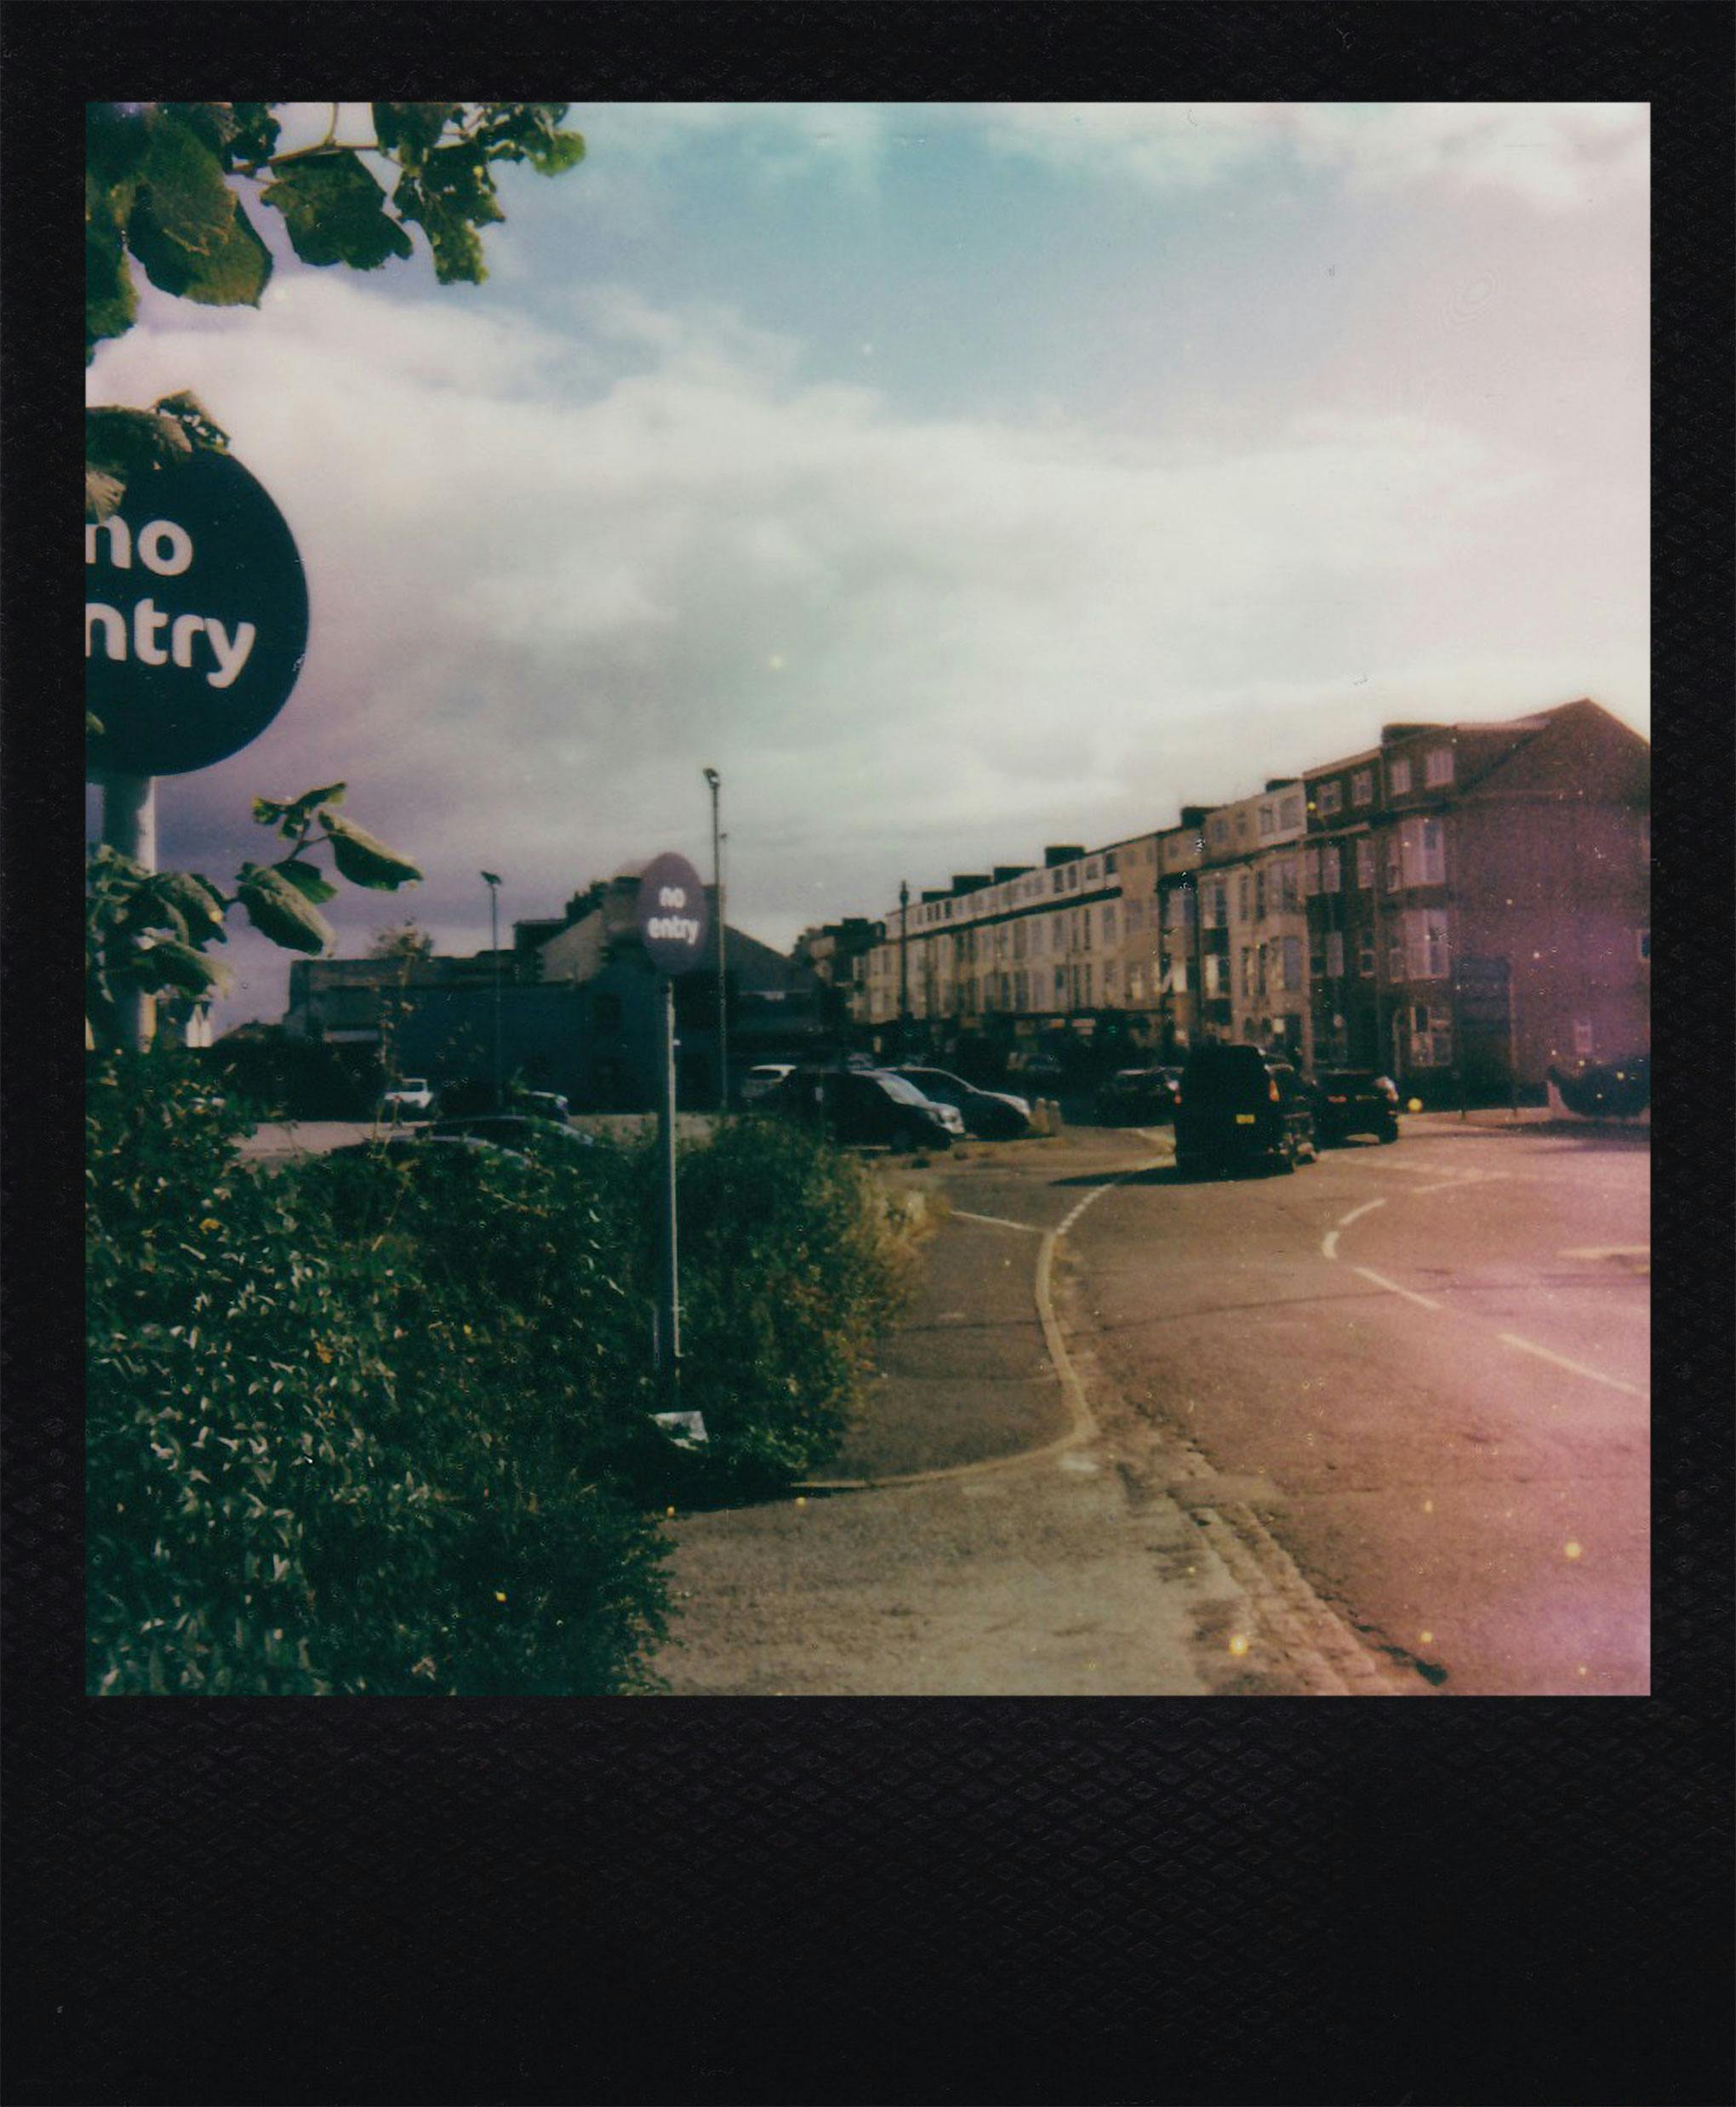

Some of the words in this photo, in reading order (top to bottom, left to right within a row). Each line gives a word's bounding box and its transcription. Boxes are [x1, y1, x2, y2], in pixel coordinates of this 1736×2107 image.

[85, 515, 192, 576] no
[85, 598, 255, 688] ntry
[659, 886, 686, 909] no
[648, 916, 700, 945] entry
